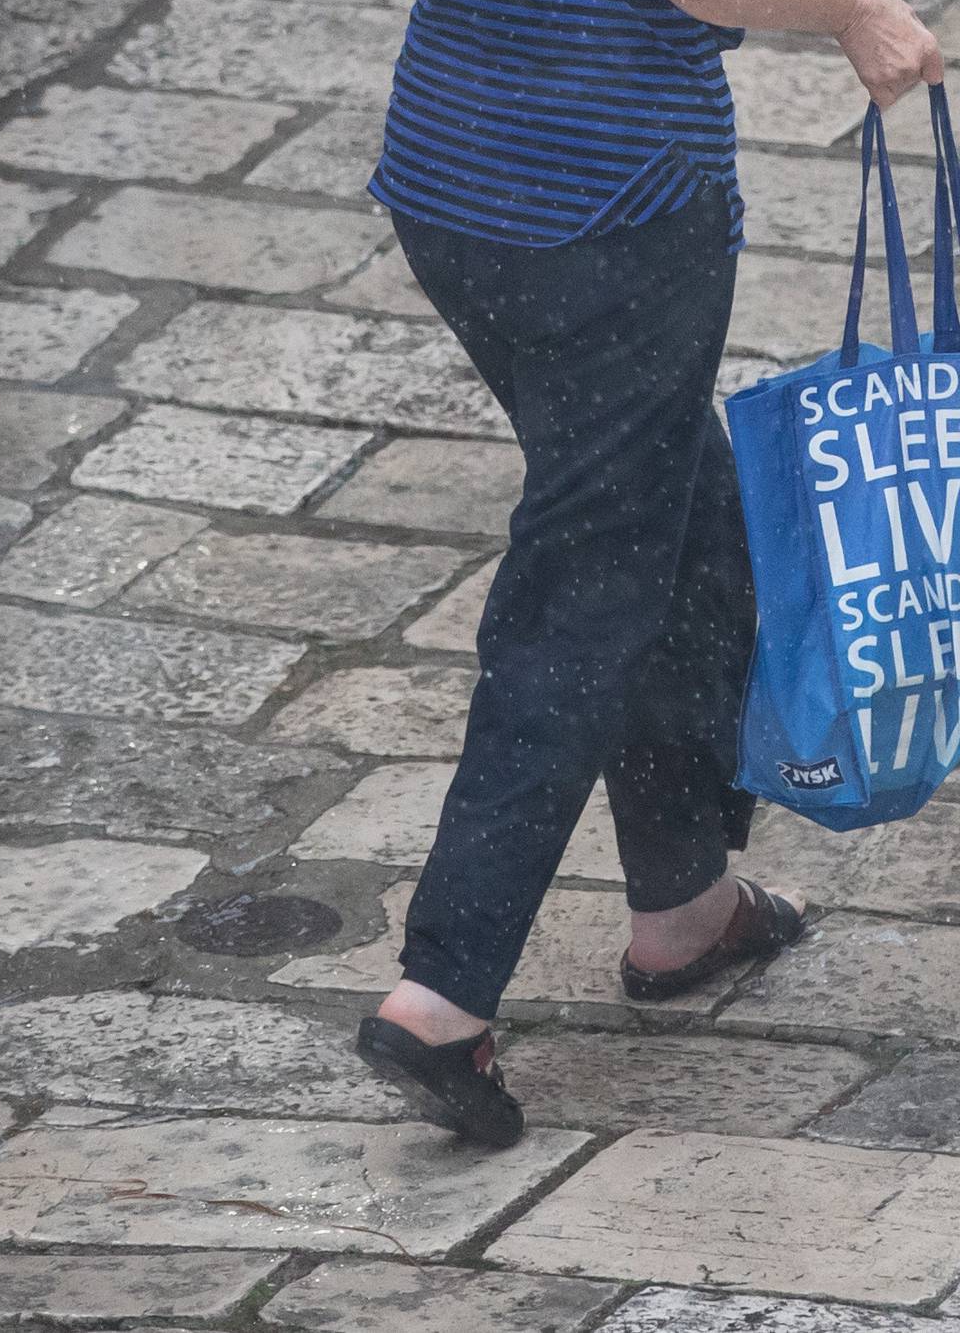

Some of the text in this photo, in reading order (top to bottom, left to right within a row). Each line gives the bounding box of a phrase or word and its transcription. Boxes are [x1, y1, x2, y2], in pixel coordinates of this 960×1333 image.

[799, 362, 959, 426] SCAND
[807, 408, 960, 492] SLEE
[818, 478, 960, 587] LIV
[792, 763, 840, 785] JYSK
